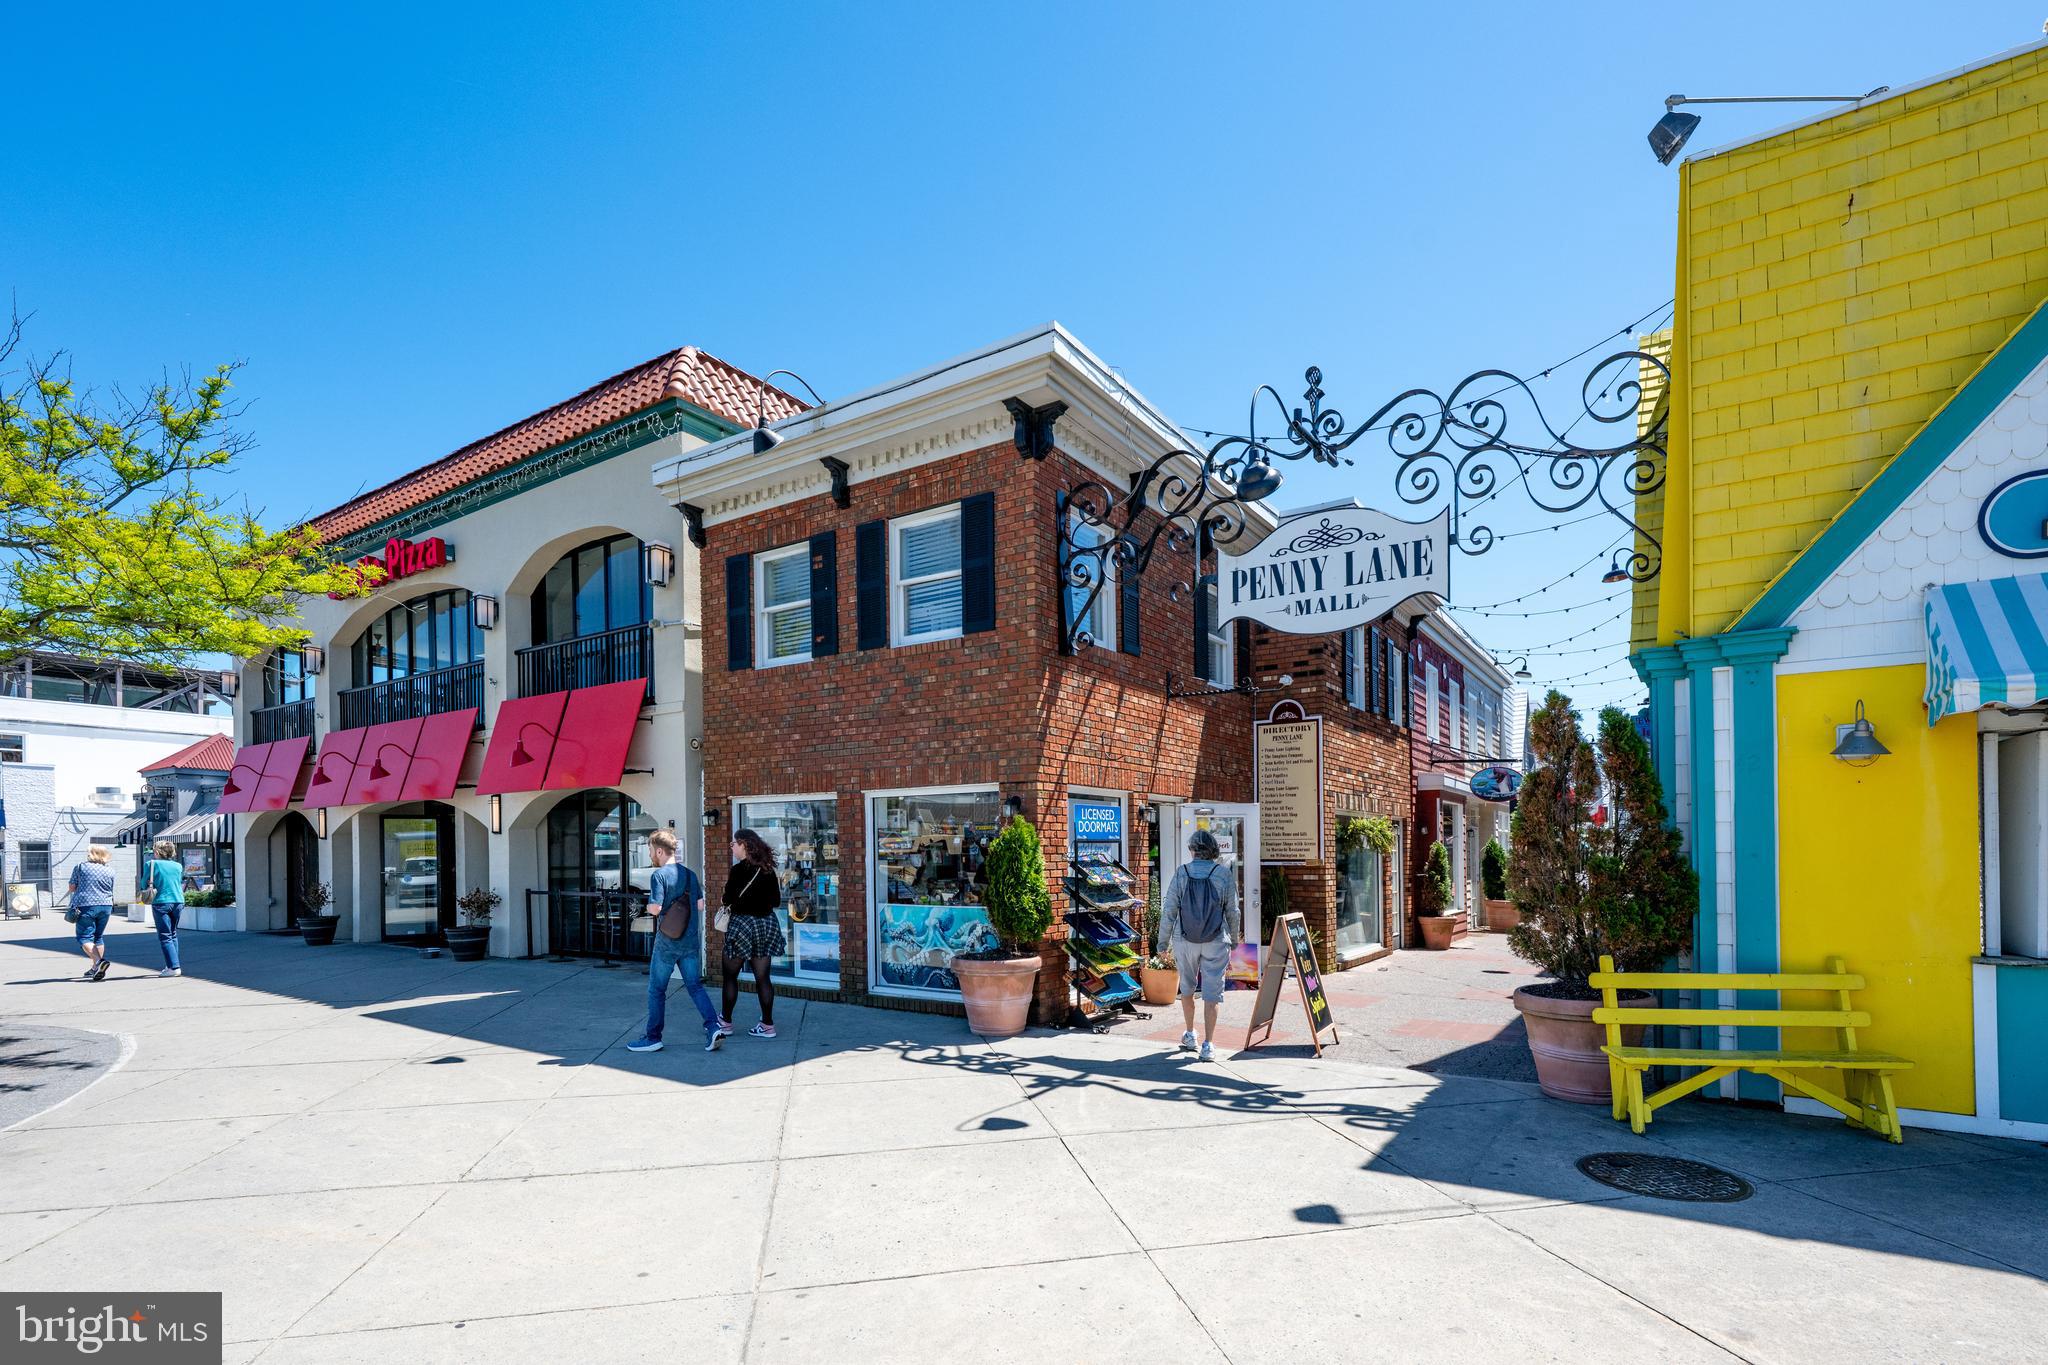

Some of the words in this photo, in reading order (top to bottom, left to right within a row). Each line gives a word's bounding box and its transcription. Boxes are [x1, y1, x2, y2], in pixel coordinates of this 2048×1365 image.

[385, 538, 440, 580] Pizza
[1231, 554, 1329, 604] PENNY
[1343, 537, 1434, 587] LANE
[1294, 593, 1360, 617] MALL
[1263, 724, 1312, 735] DIRECTORY
[1289, 733, 1304, 741] LANE
[1081, 808, 1115, 820] LICENSED
[1078, 820, 1119, 832] DOORMATS
